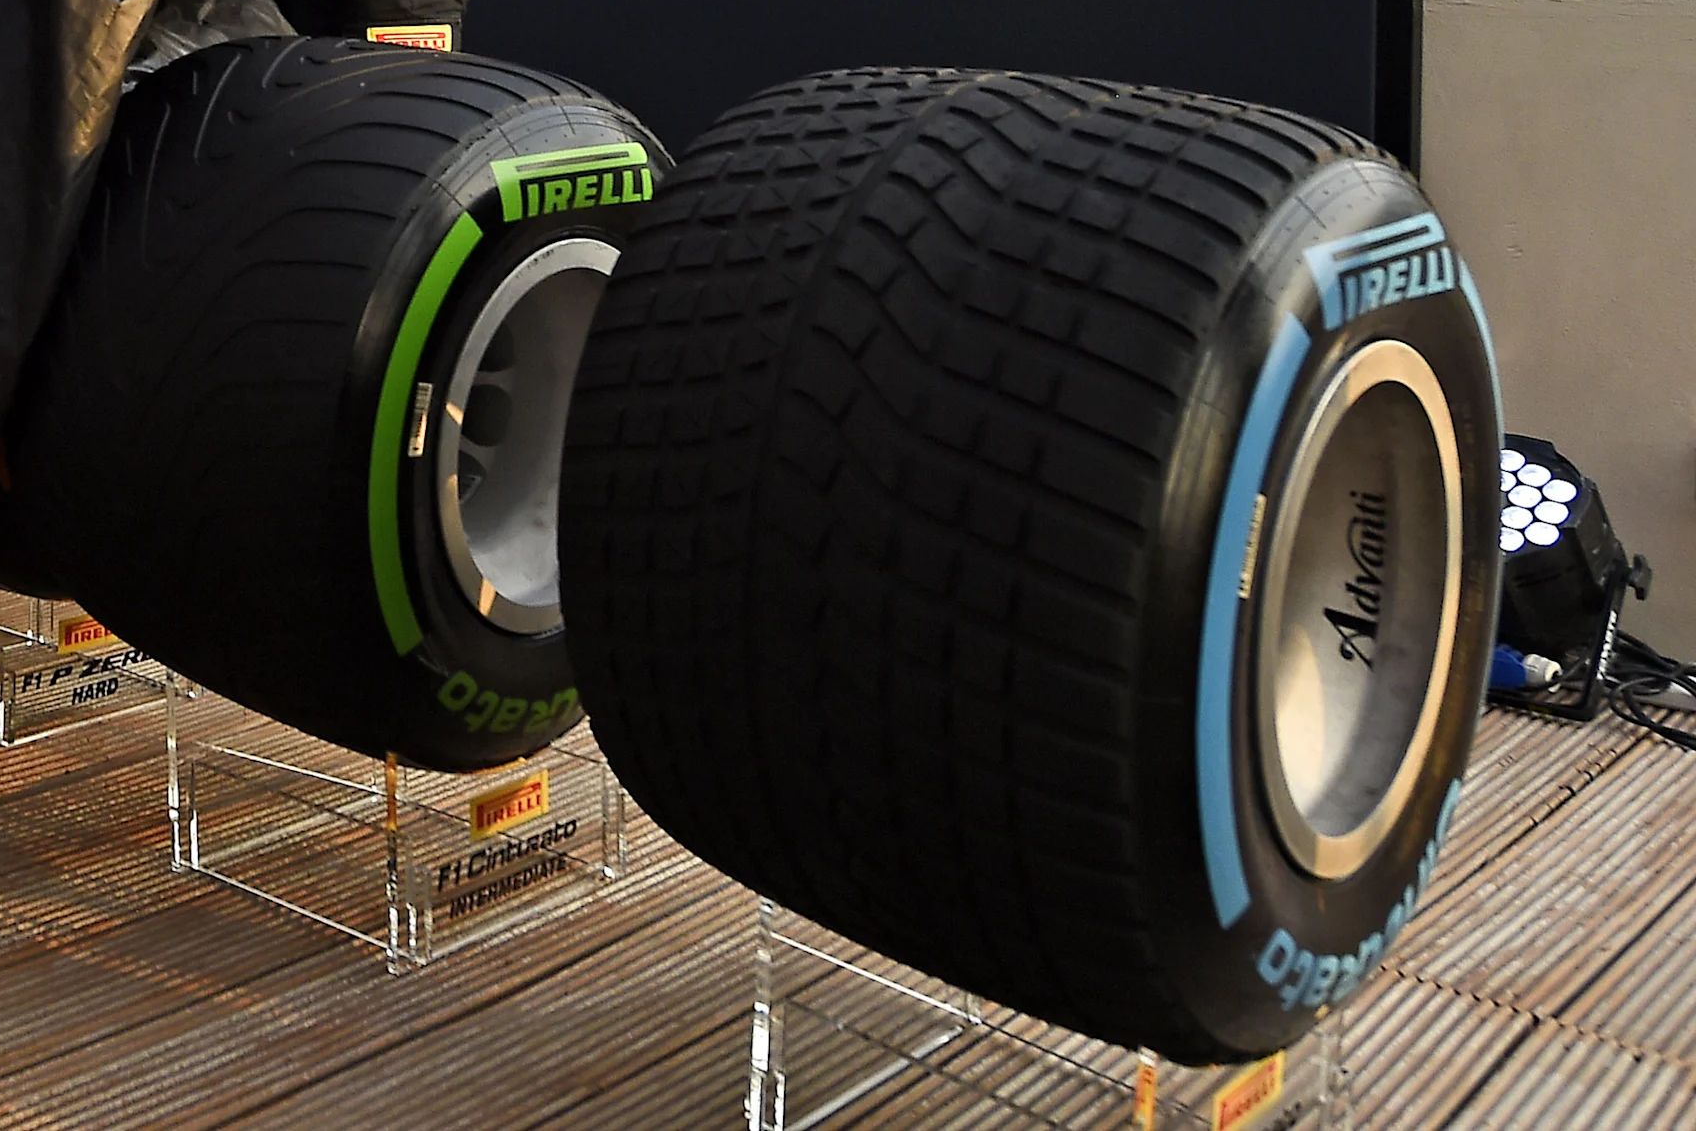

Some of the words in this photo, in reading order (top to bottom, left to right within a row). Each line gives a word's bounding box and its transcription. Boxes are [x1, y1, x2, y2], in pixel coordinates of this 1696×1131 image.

[376, 32, 446, 48] PRELLI
[490, 141, 654, 223] PIRELLI
[1304, 211, 1454, 331] PIRELLI
[1323, 490, 1387, 670] Advanti
[49, 665, 74, 687] P
[78, 649, 154, 679] ZER
[71, 677, 119, 706] HARD
[475, 781, 543, 832] PIRELLI
[450, 855, 567, 919] INTERMEDIATE
